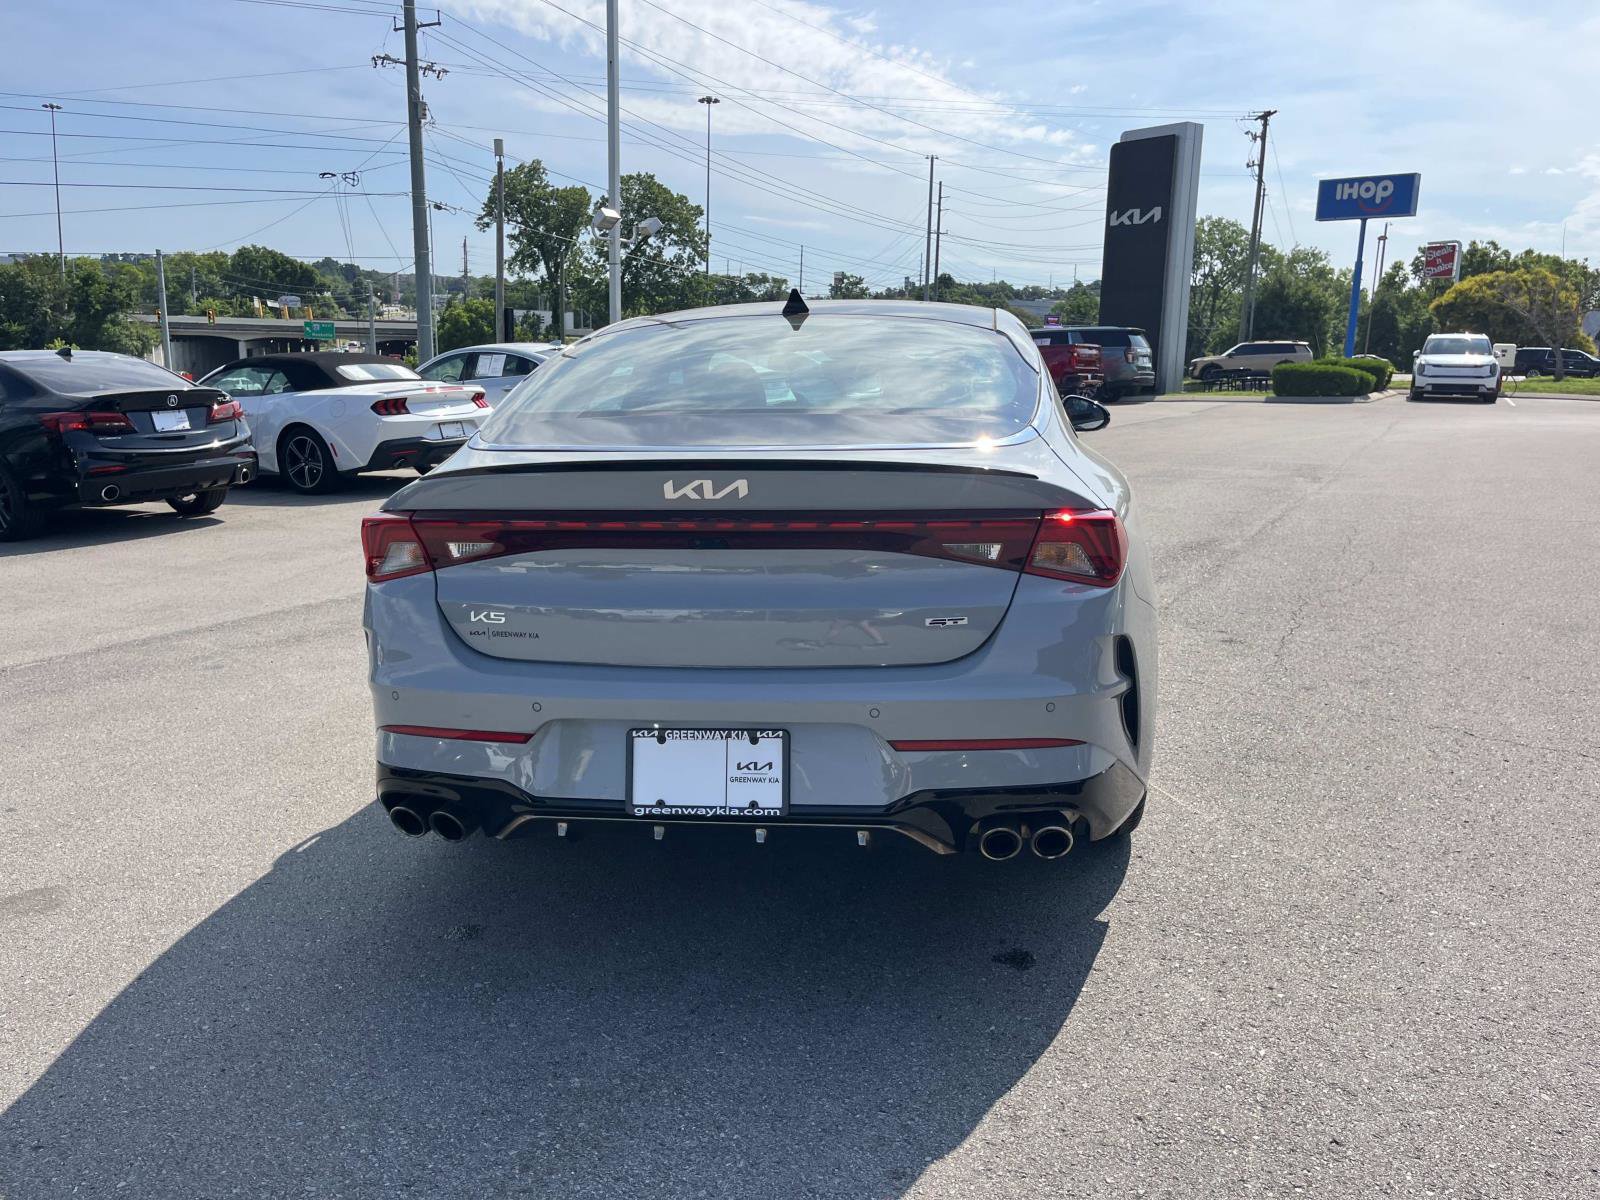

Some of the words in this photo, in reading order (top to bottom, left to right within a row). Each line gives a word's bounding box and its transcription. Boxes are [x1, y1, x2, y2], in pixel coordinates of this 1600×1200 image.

[1336, 179, 1394, 204] IHOP
[1110, 206, 1162, 226] KIA
[1426, 245, 1454, 260] Steak
[1424, 262, 1454, 277] Shake
[663, 479, 749, 499] KIA
[470, 610, 506, 624] K5
[492, 630, 527, 638] GREENWAY
[528, 631, 540, 639] KIA
[664, 730, 729, 740] GREENWAY
[729, 730, 750, 740] KIA
[756, 730, 783, 738] KIA
[736, 761, 773, 771] KIA
[729, 776, 767, 784] GREENWAY
[634, 806, 781, 817] greenwaykia.com
